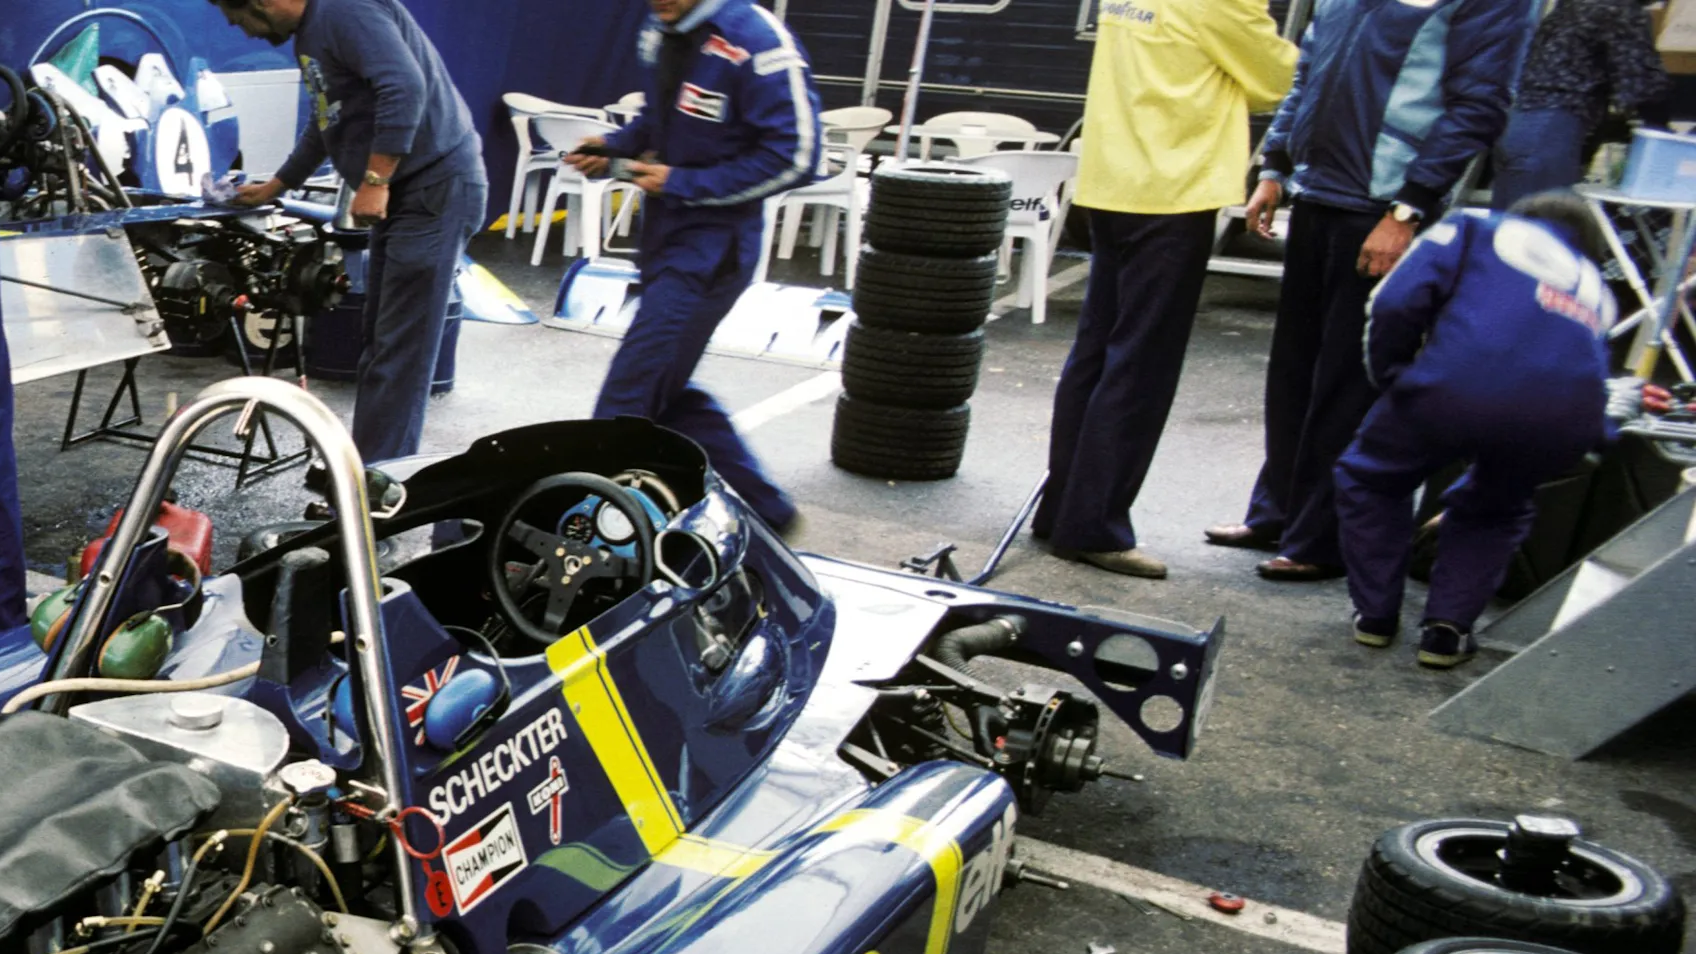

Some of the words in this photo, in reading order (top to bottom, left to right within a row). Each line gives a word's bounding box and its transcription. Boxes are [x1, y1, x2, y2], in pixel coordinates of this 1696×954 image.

[173, 116, 194, 187] 4
[1010, 197, 1043, 211] elf
[428, 706, 569, 827] SCHECKTER
[531, 773, 566, 809] KONI
[454, 830, 516, 886] CHAMPION
[956, 801, 1017, 934] elf
